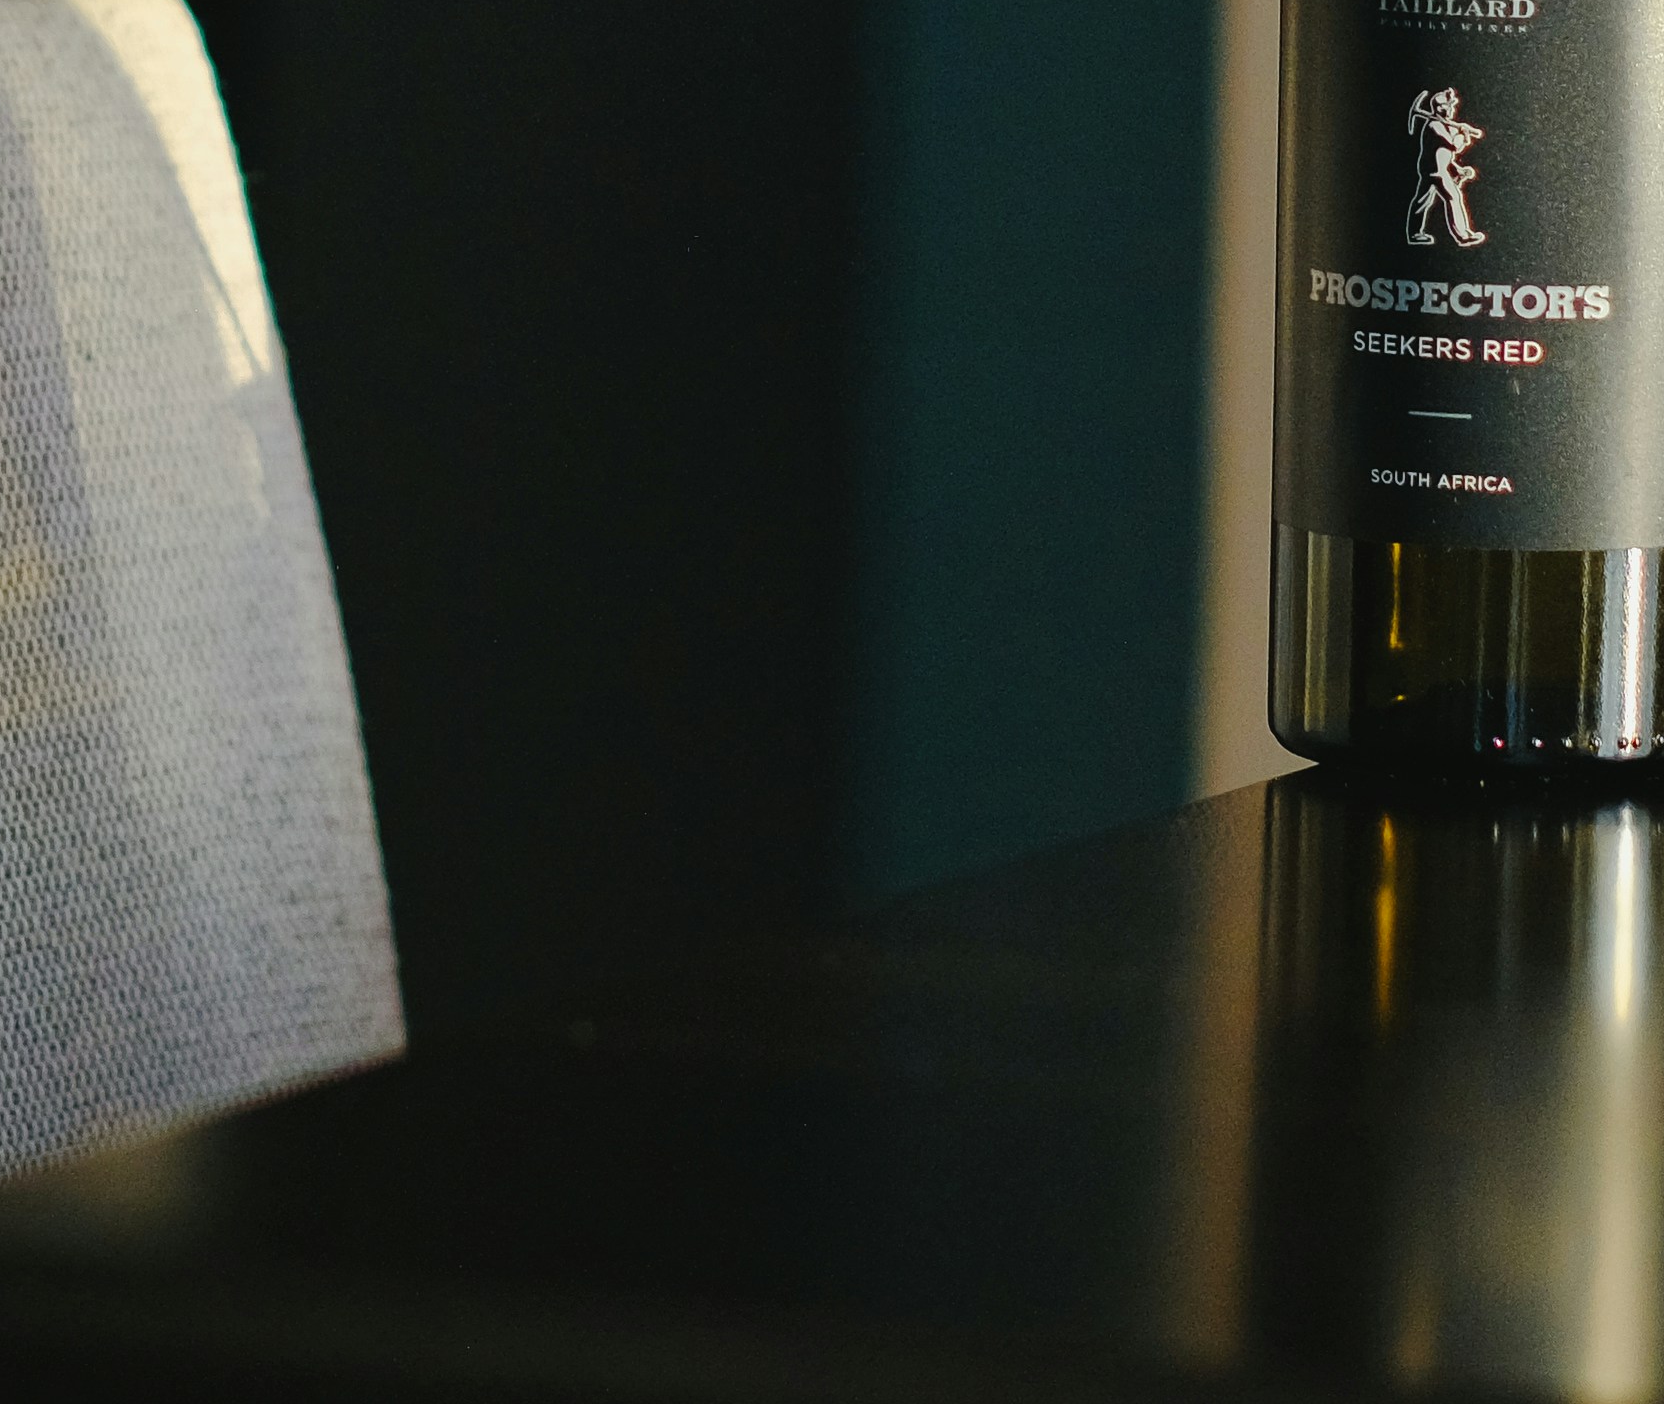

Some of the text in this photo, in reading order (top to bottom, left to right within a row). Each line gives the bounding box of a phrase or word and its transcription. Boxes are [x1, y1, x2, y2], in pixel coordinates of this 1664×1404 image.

[1310, 268, 1610, 320] PROSPECTOR'S
[1353, 331, 1543, 363] SEEKERS RED
[1371, 468, 1513, 493] SOUTH AFRICA
